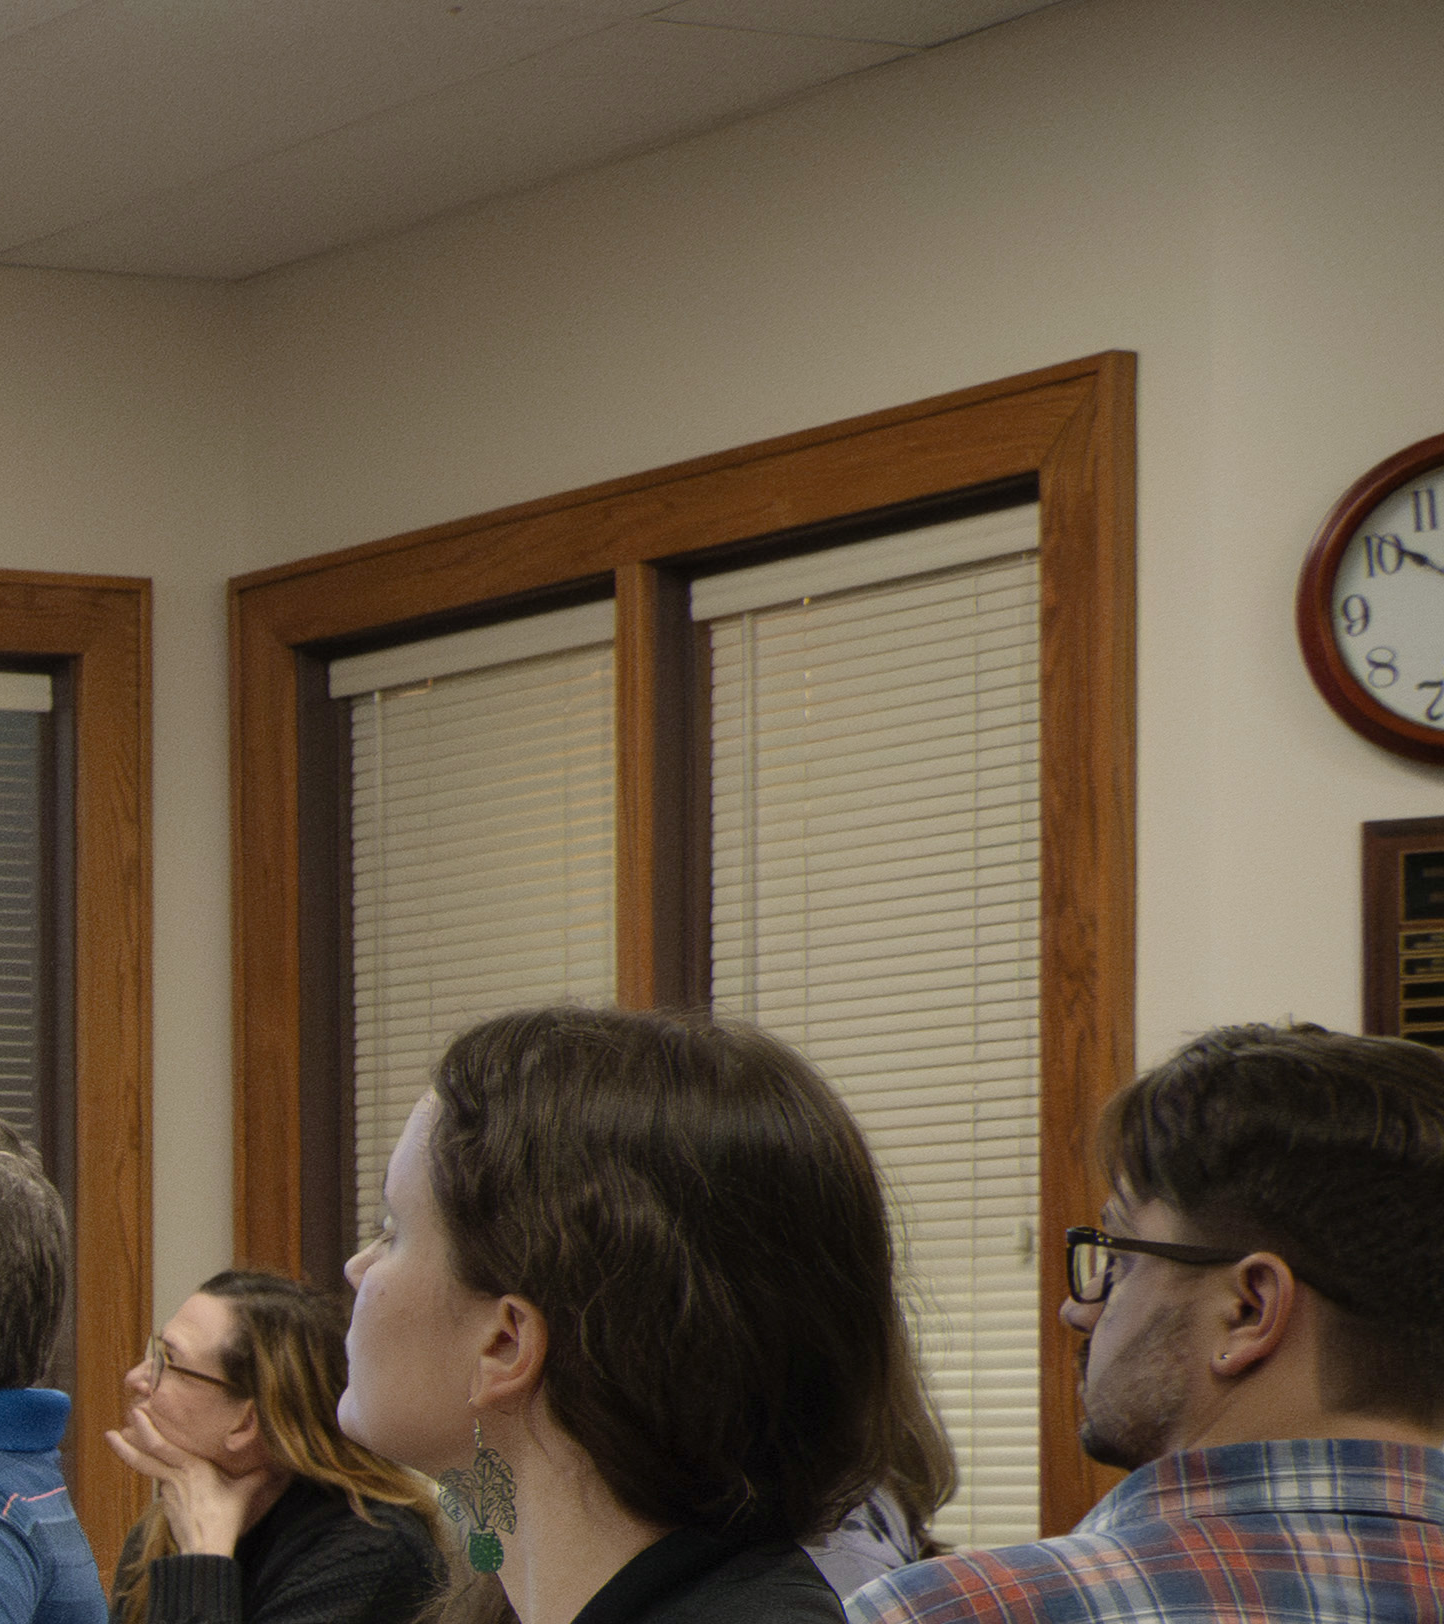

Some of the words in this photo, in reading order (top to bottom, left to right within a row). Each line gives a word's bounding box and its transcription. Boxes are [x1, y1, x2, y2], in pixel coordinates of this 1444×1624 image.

[1414, 488, 1437, 532] 11
[1365, 533, 1404, 578] 10
[1342, 594, 1370, 637] 9
[1366, 647, 1398, 689] 8
